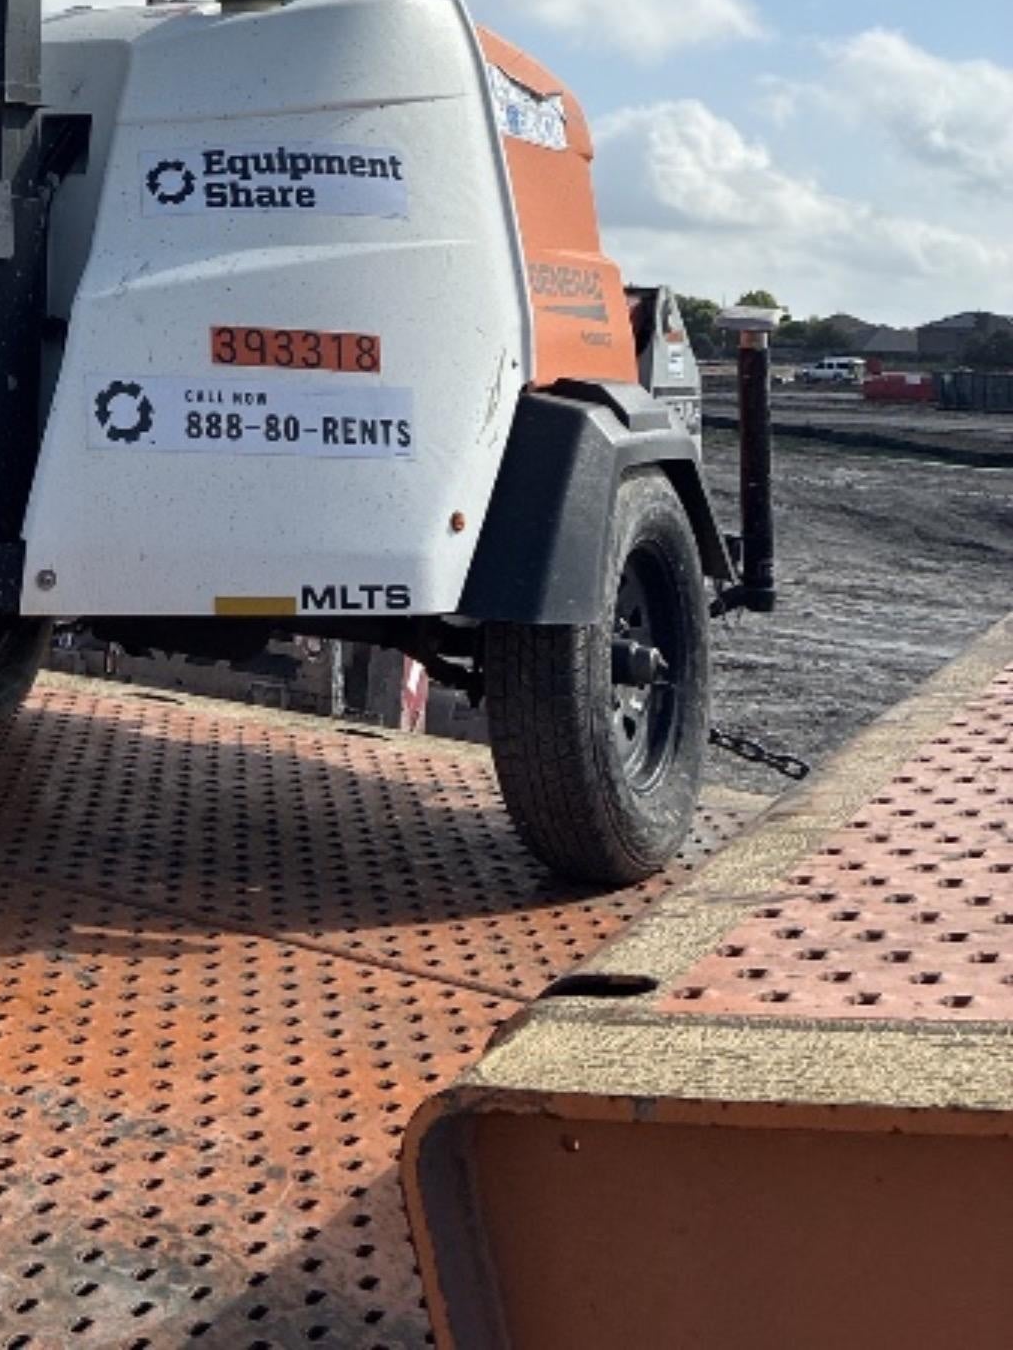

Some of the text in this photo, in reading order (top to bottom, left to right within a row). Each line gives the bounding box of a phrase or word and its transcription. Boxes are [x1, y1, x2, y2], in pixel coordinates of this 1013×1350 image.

[202, 147, 403, 181] Equipment
[204, 179, 316, 208] Share
[214, 327, 379, 372] 393318
[184, 389, 268, 406] CALL NOW
[186, 410, 412, 448] 888-80-RENTS
[301, 584, 411, 610] MLTS
